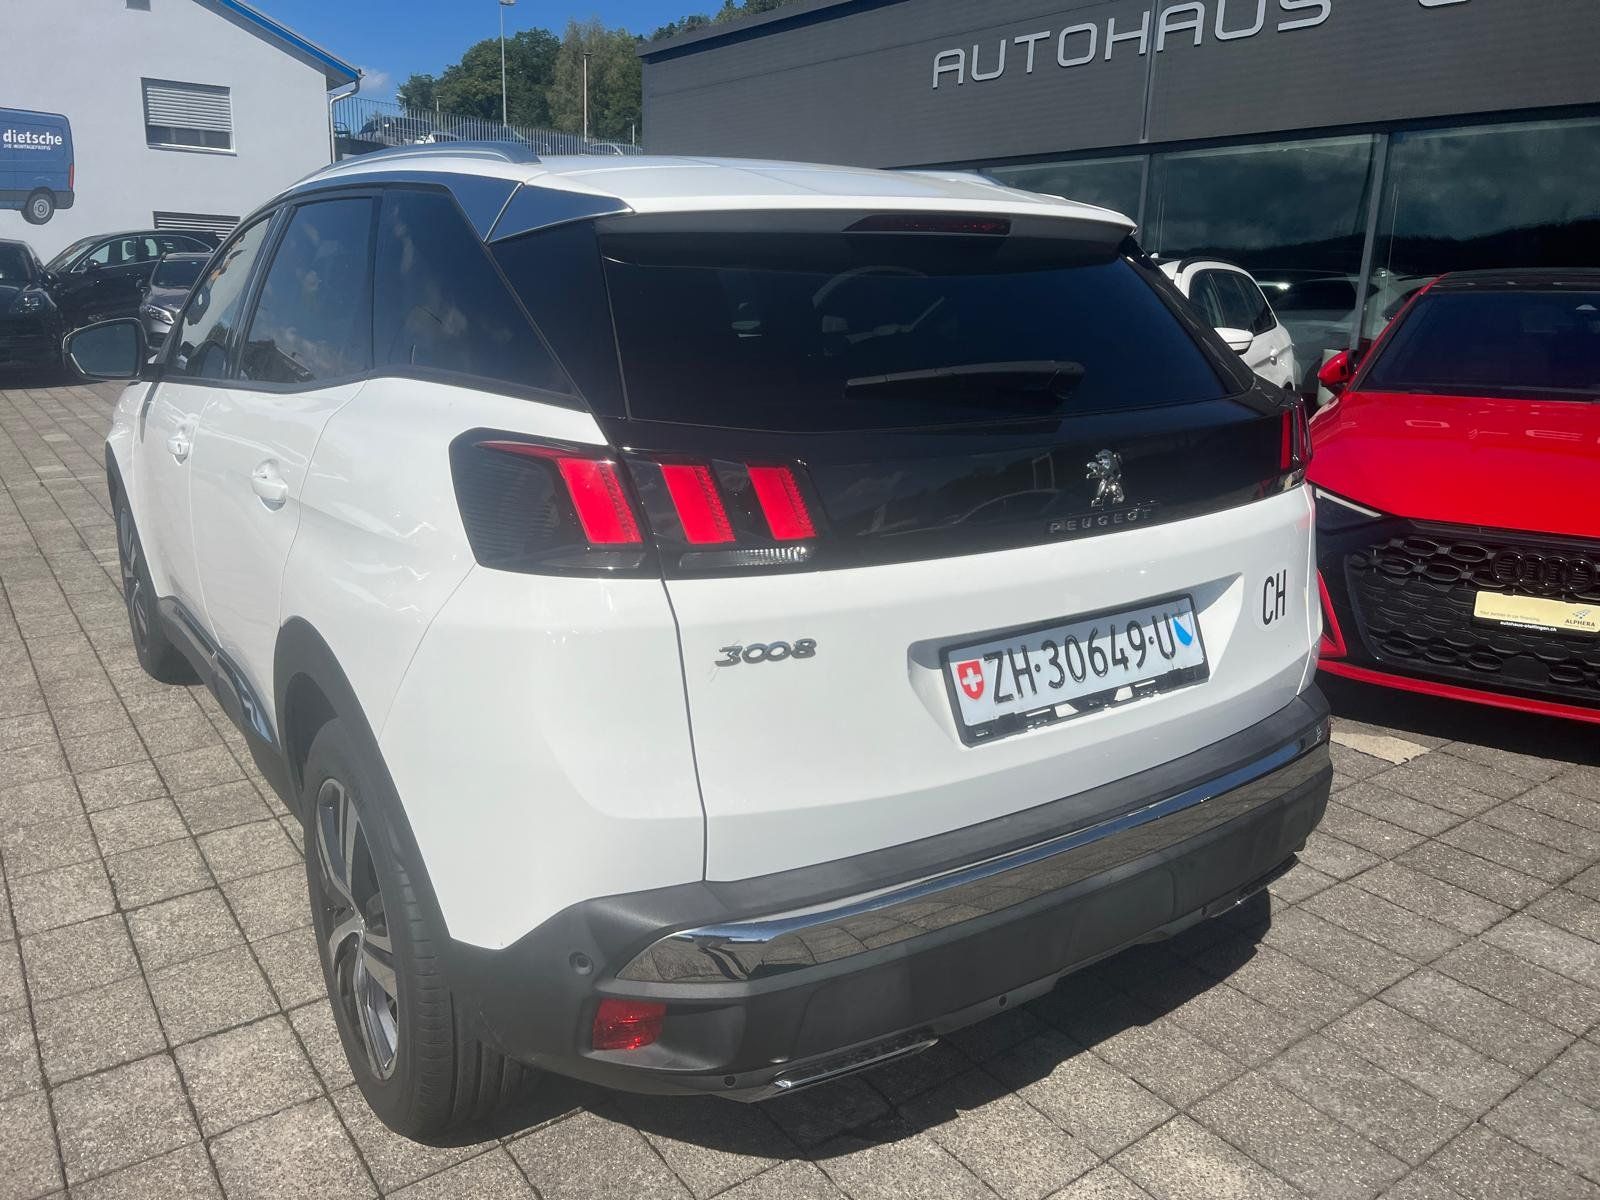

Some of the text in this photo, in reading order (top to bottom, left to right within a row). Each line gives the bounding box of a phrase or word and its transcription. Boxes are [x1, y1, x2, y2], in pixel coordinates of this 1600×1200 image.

[932, 0, 1332, 89] AUTOHAUS
[3, 129, 63, 145] dietsche
[1048, 508, 1152, 533] PEUGEOT
[1262, 572, 1287, 625] CH
[1565, 618, 1596, 627] ALPHERA
[714, 638, 817, 667] 3008
